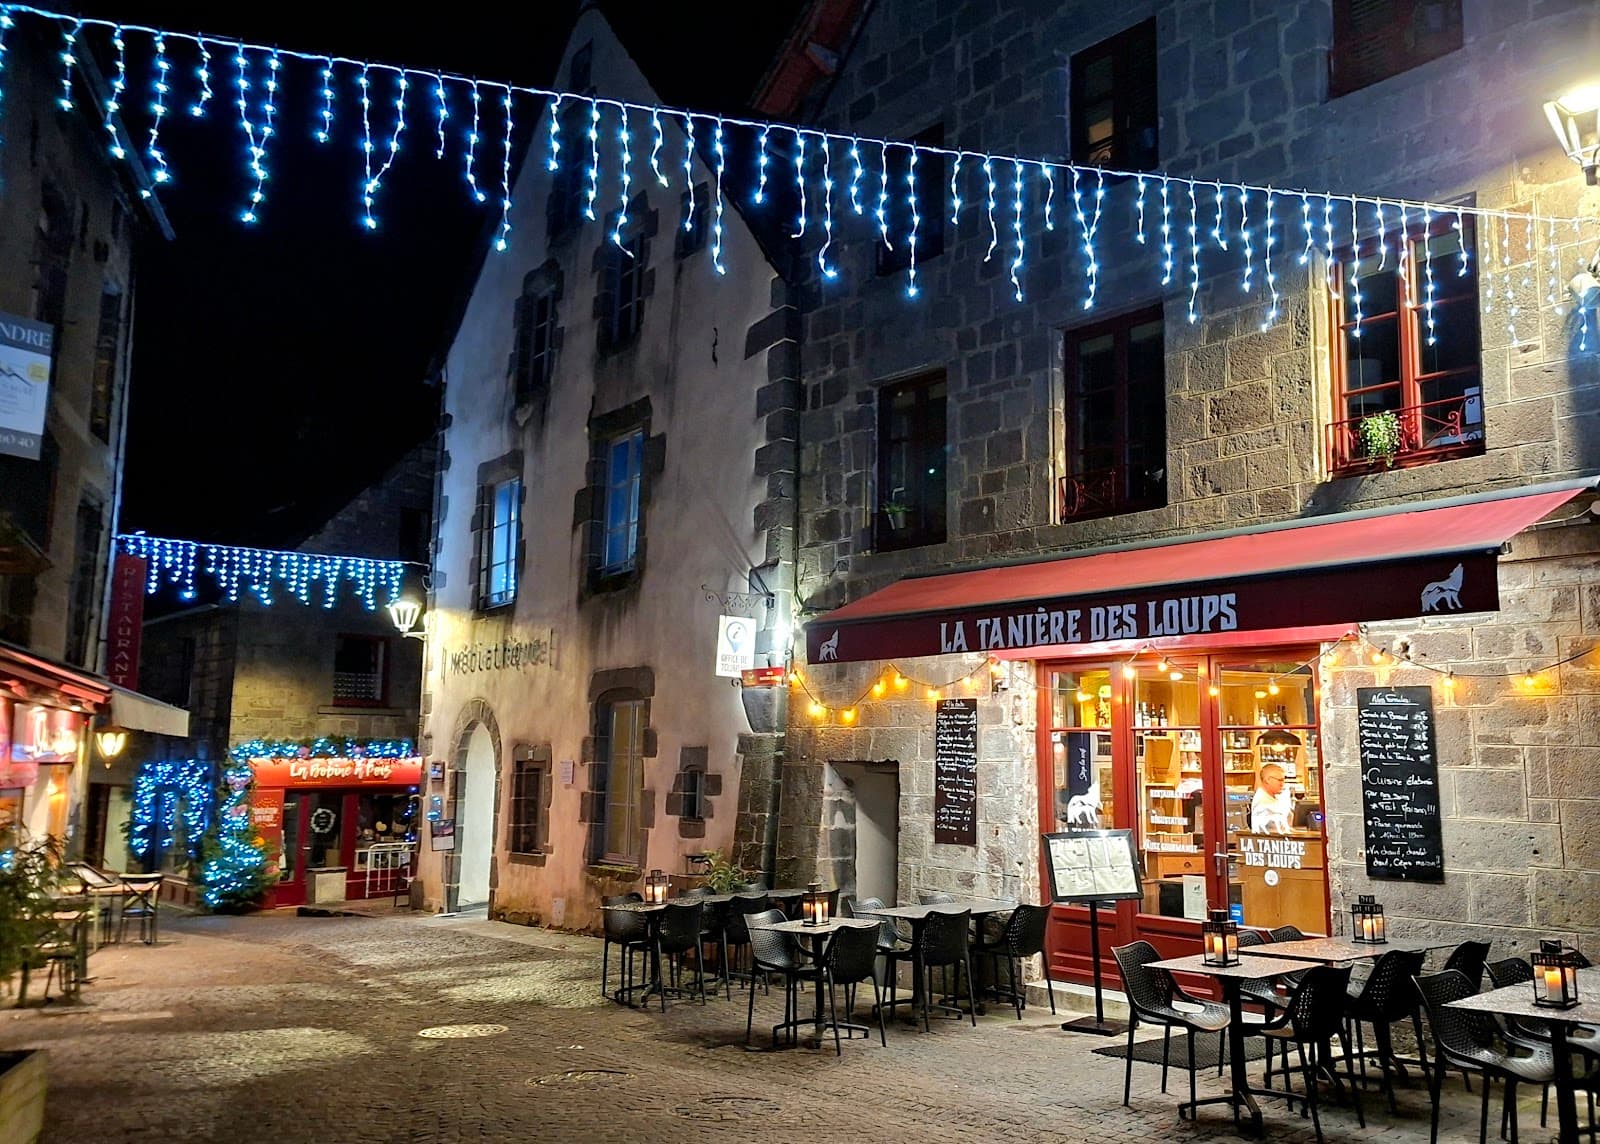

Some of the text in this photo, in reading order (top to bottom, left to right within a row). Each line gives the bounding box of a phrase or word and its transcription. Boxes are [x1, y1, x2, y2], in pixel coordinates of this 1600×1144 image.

[115, 567, 137, 685] RESTAURANT
[940, 593, 1238, 653] LA TANIÈRE DES LOUPS
[1367, 767, 1403, 785] Cuisine
[1240, 837, 1306, 856] LA TANIÈRE
[1245, 852, 1301, 870] DES LOUPS
